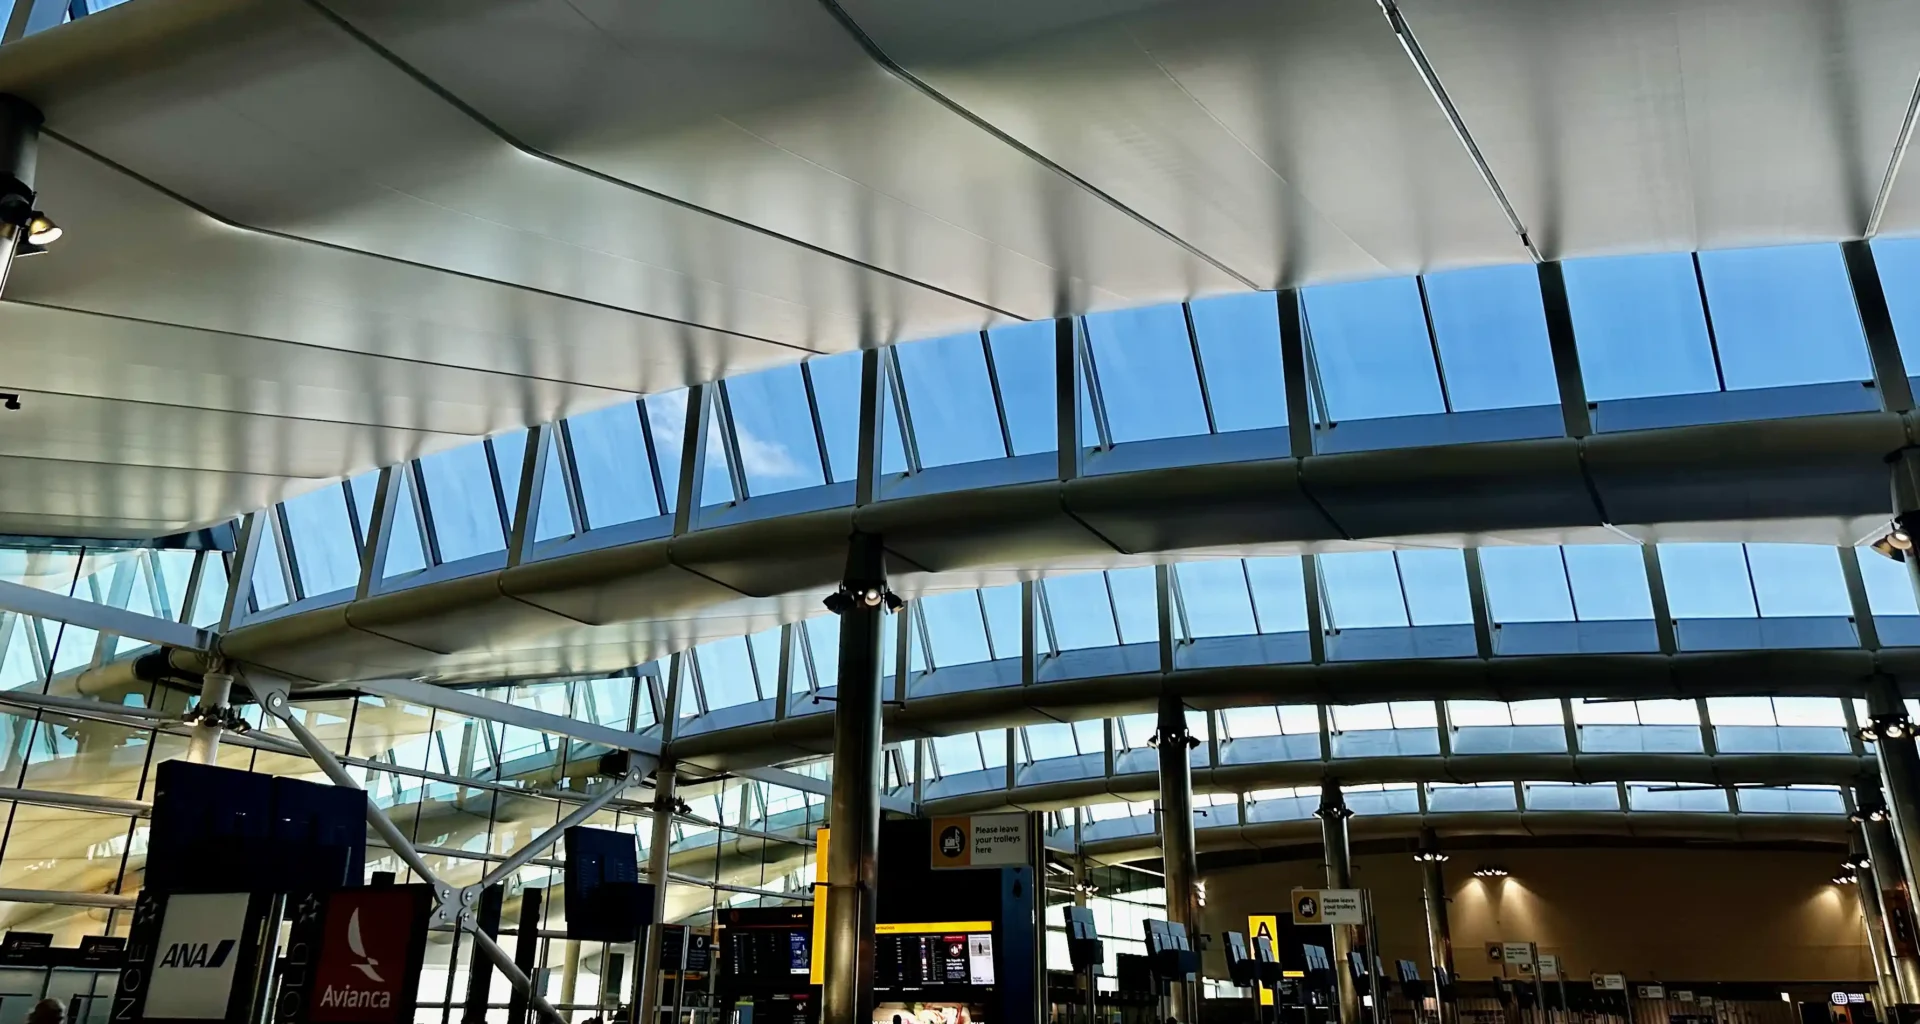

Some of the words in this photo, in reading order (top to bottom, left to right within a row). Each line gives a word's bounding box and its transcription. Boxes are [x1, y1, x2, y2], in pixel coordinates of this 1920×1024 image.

[975, 826, 998, 834] Please
[975, 836, 992, 845] your
[993, 835, 1021, 844] trolleys
[975, 846, 992, 854] here
[1257, 921, 1273, 941] A
[159, 942, 209, 968] ANA
[282, 942, 309, 1024] OLD
[320, 984, 391, 1009] Avianca
